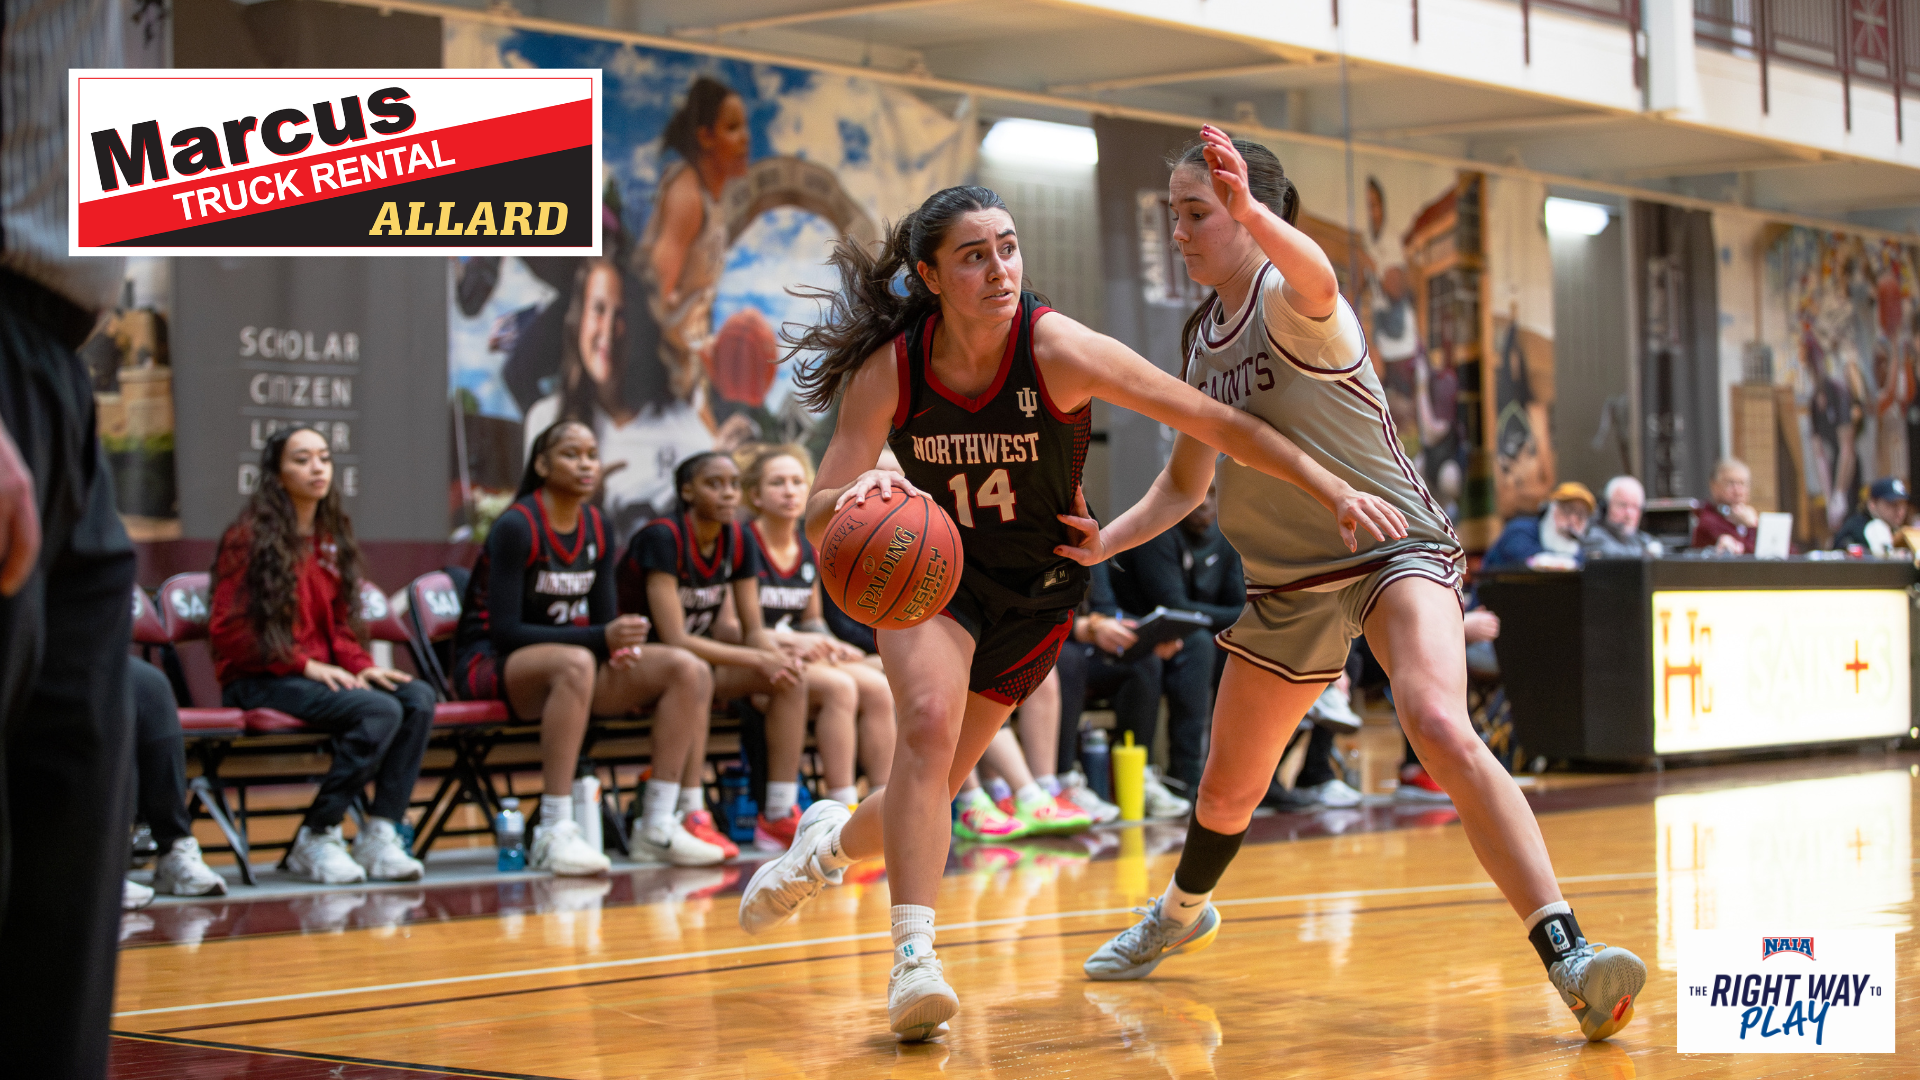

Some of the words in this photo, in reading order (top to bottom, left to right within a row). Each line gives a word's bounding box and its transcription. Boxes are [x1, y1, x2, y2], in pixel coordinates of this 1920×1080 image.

[239, 326, 360, 362] SCHOLAR
[250, 373, 351, 407] CITIZEN
[912, 432, 1039, 464] NORTHWEST
[947, 468, 1017, 529] 14
[824, 515, 865, 578] NAIA
[856, 525, 917, 615] SPALDING
[893, 546, 941, 622] LEGACY
